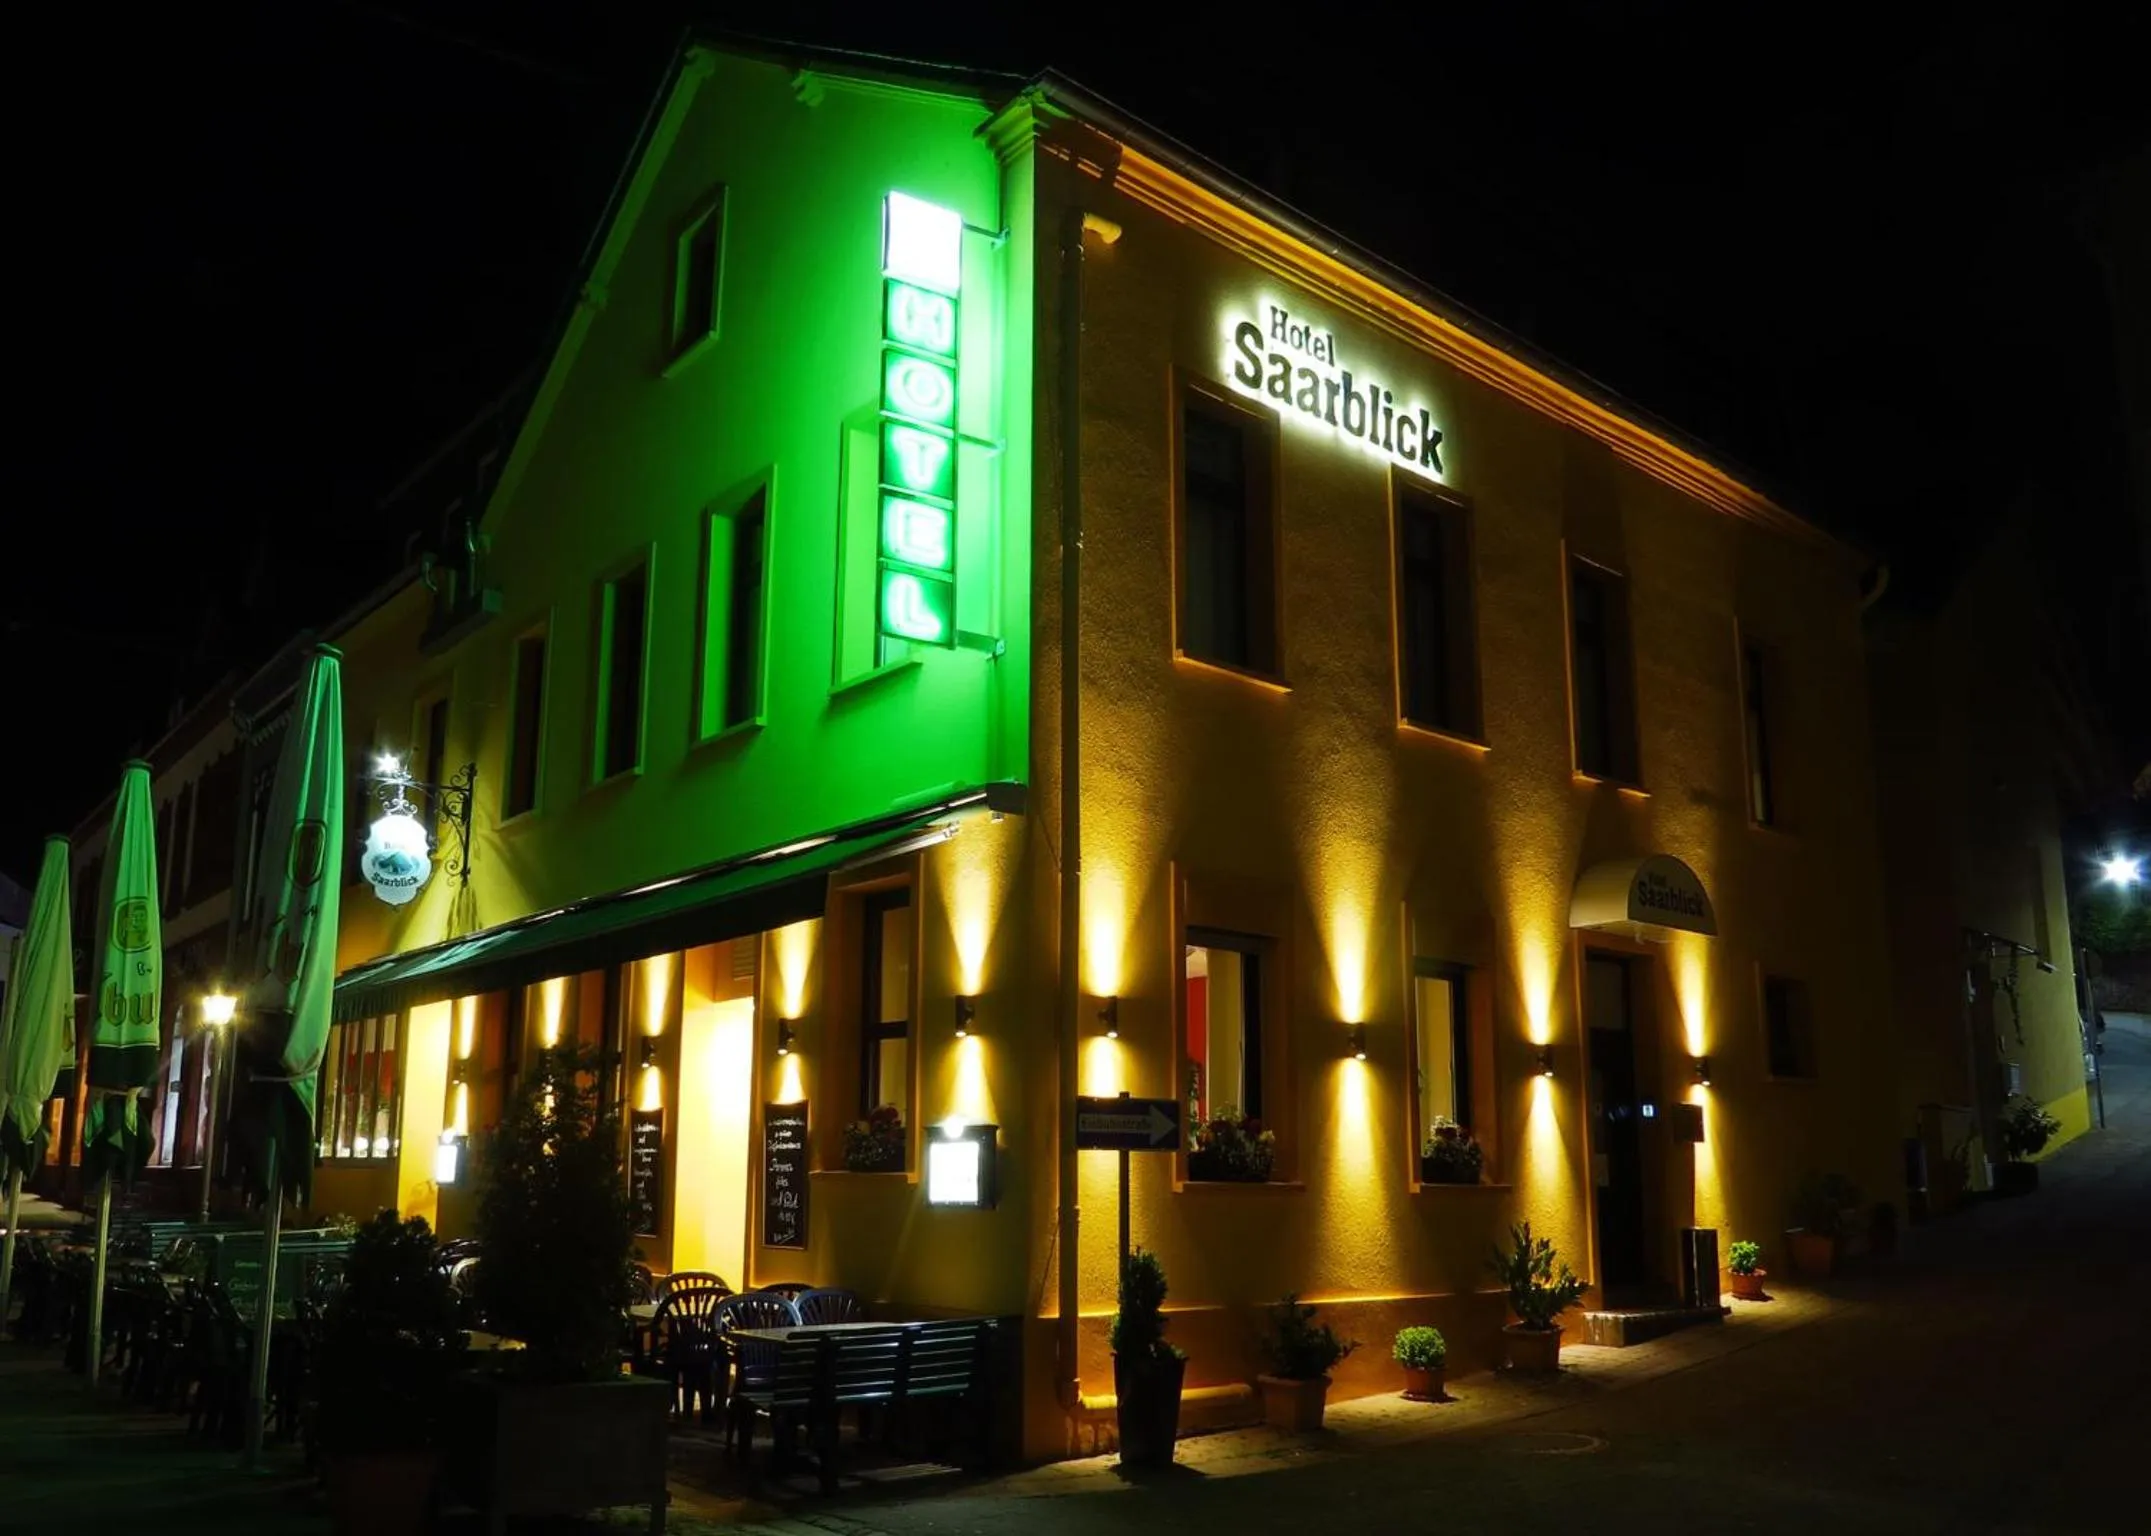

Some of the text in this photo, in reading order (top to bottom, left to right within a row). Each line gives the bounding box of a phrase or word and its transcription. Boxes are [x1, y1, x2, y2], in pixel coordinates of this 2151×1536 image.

[1234, 321, 1443, 475] Saarblick
[1270, 305, 1335, 367] Hotel
[887, 281, 955, 644] HOTEL
